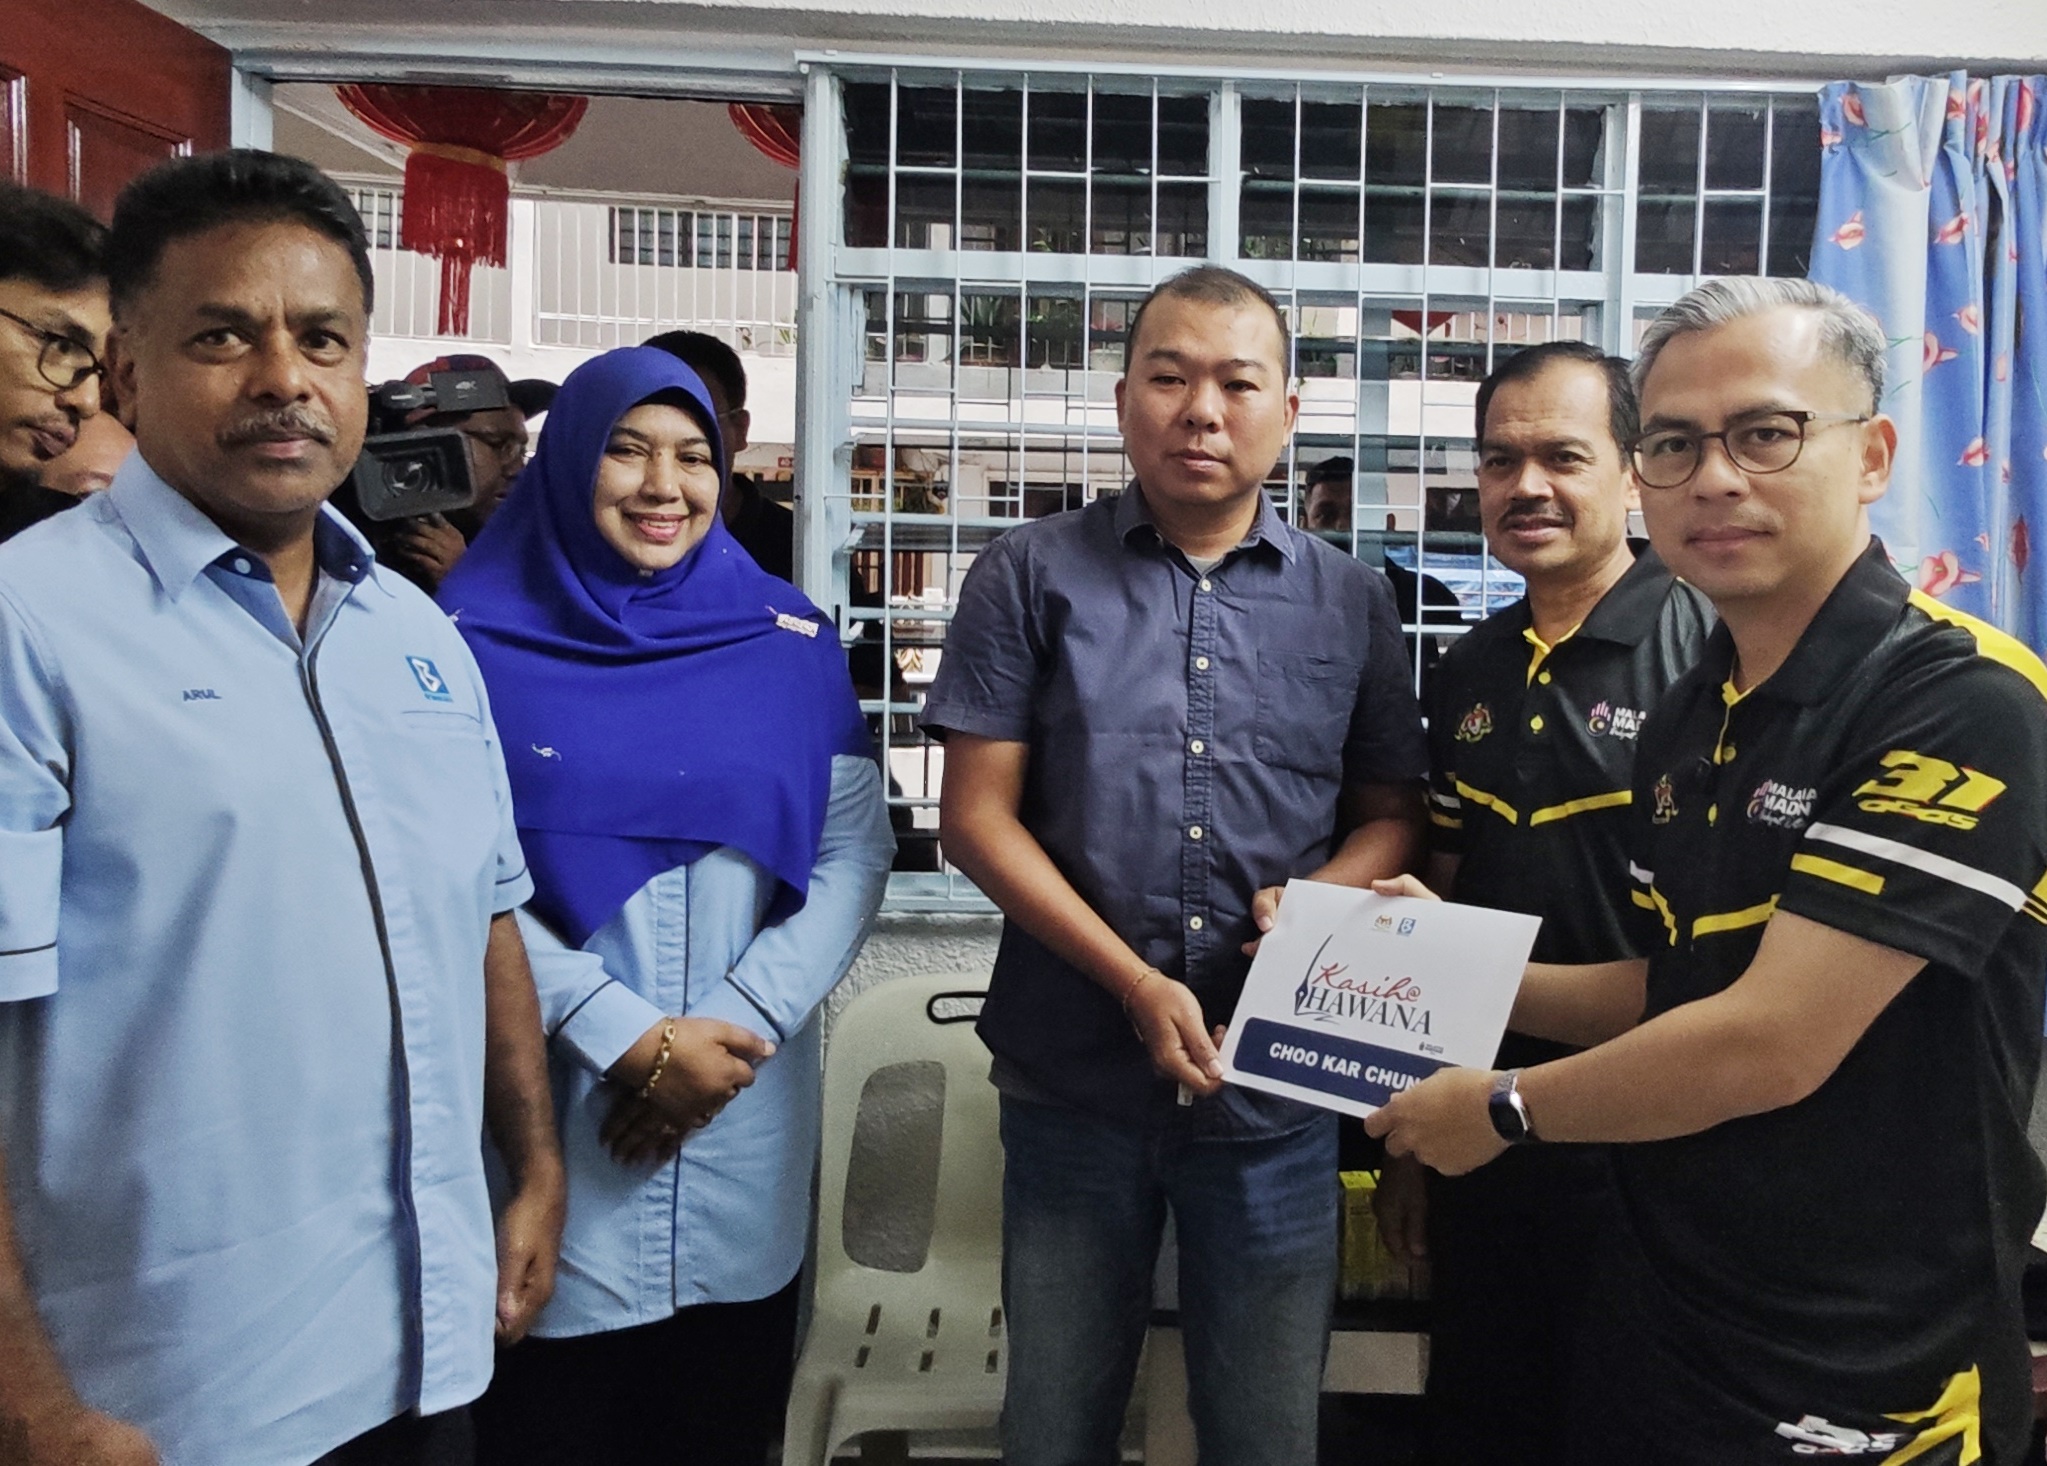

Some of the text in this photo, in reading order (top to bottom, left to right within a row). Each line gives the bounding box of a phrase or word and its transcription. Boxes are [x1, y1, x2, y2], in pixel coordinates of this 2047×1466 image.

[182, 688, 222, 701] ARUL
[1304, 985, 1431, 1036] HAWANA
[1269, 1041, 1421, 1092] CHOO KAR CHUN
